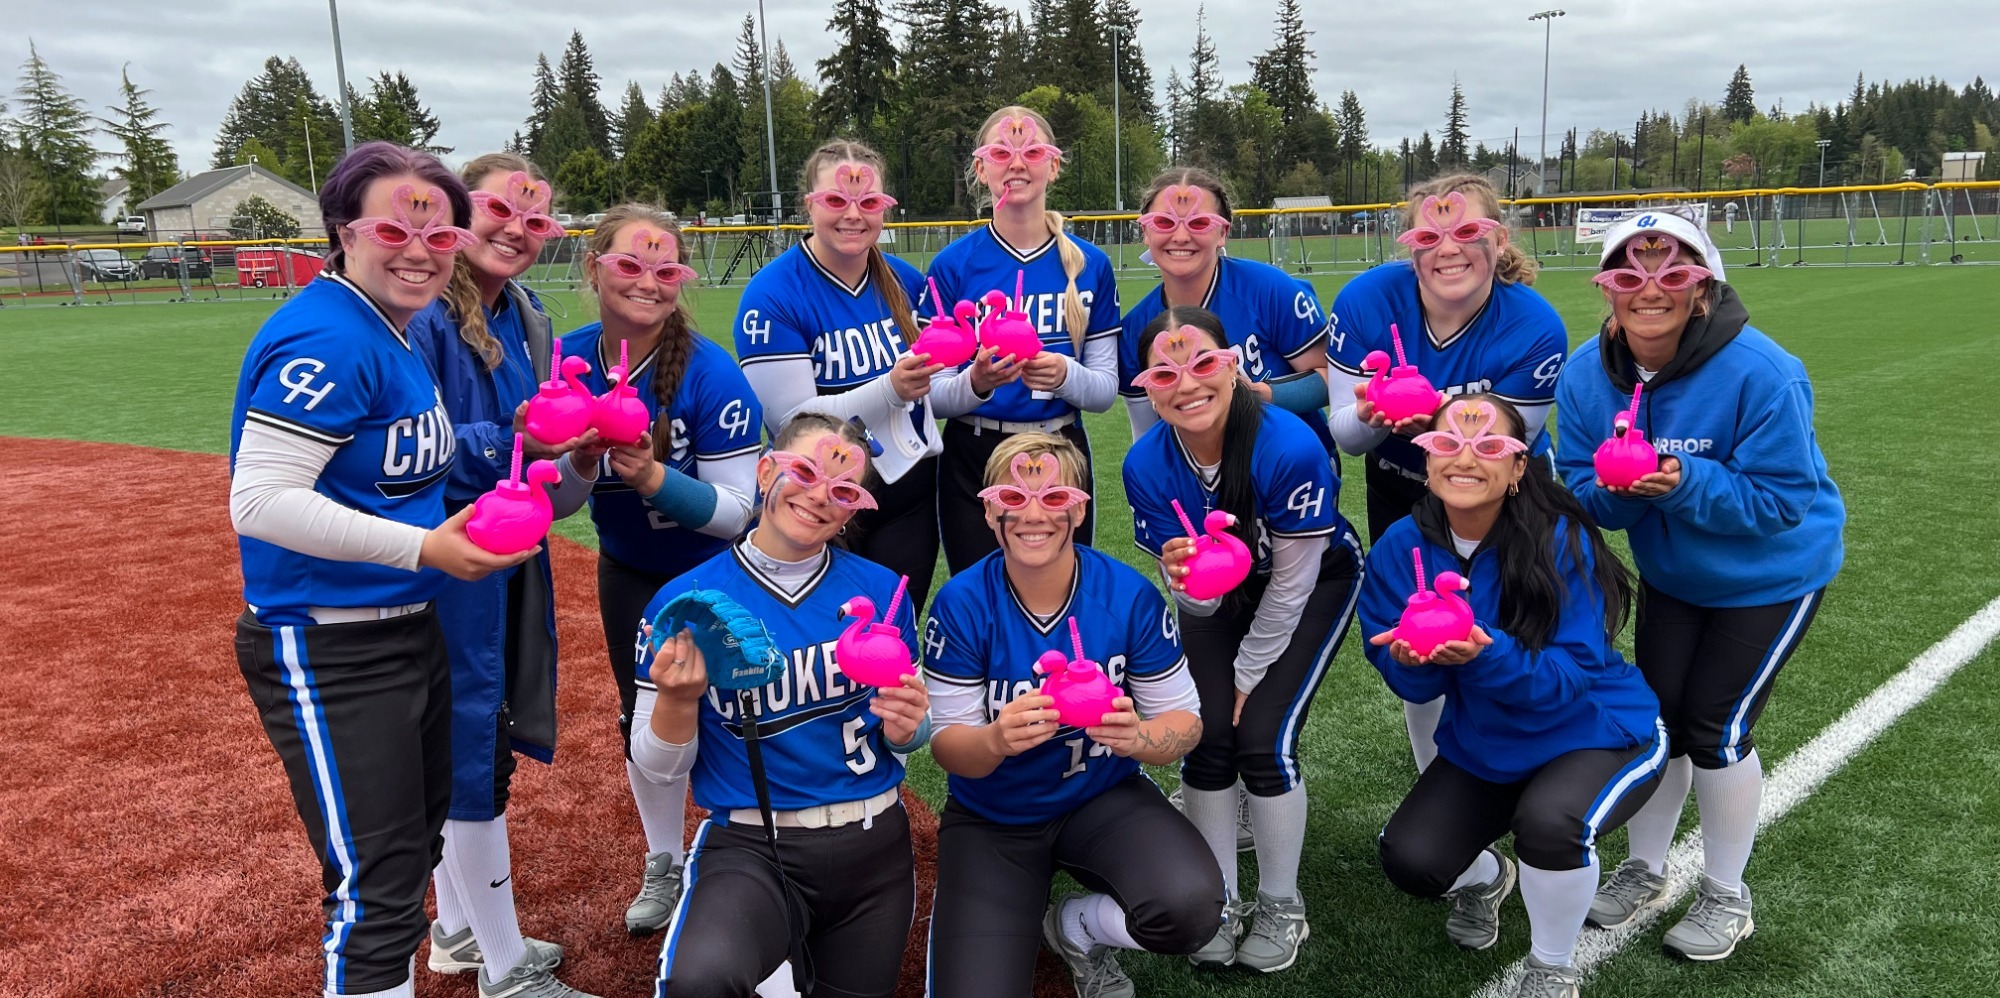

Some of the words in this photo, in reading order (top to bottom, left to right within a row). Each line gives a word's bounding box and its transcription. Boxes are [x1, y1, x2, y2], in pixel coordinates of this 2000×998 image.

[743, 309, 771, 345] GH
[1327, 312, 1346, 353] GH
[811, 318, 903, 380] CHOKE
[279, 357, 336, 412] GH
[718, 399, 750, 440] GH
[1287, 480, 1325, 519] GH
[923, 616, 946, 660] GH
[842, 715, 877, 776] 5
